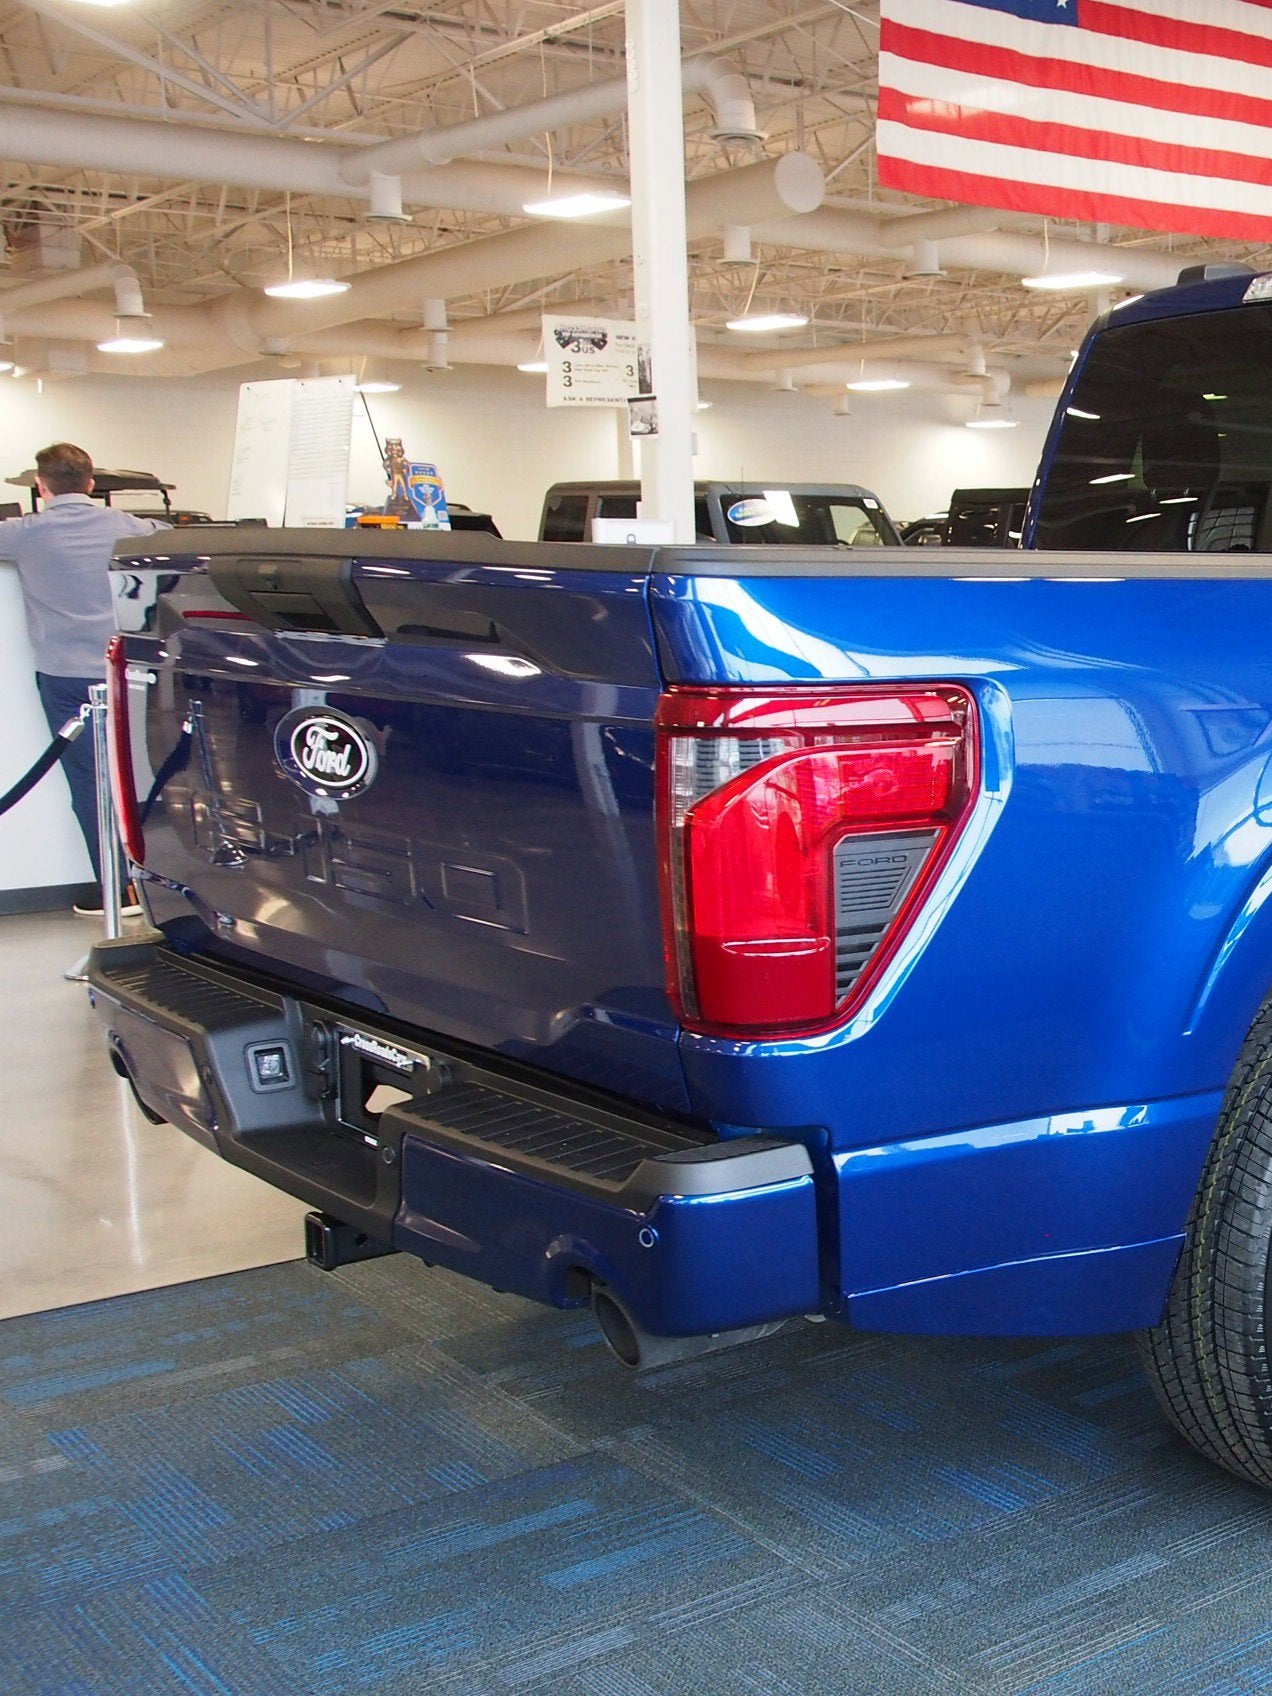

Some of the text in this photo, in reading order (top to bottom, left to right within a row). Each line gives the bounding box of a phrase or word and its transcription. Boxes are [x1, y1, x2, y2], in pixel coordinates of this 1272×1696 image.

[562, 361, 572, 373] 3
[625, 365, 634, 377] 3
[563, 375, 573, 387] 3
[302, 725, 352, 777] Ford
[839, 854, 908, 868] FORD
